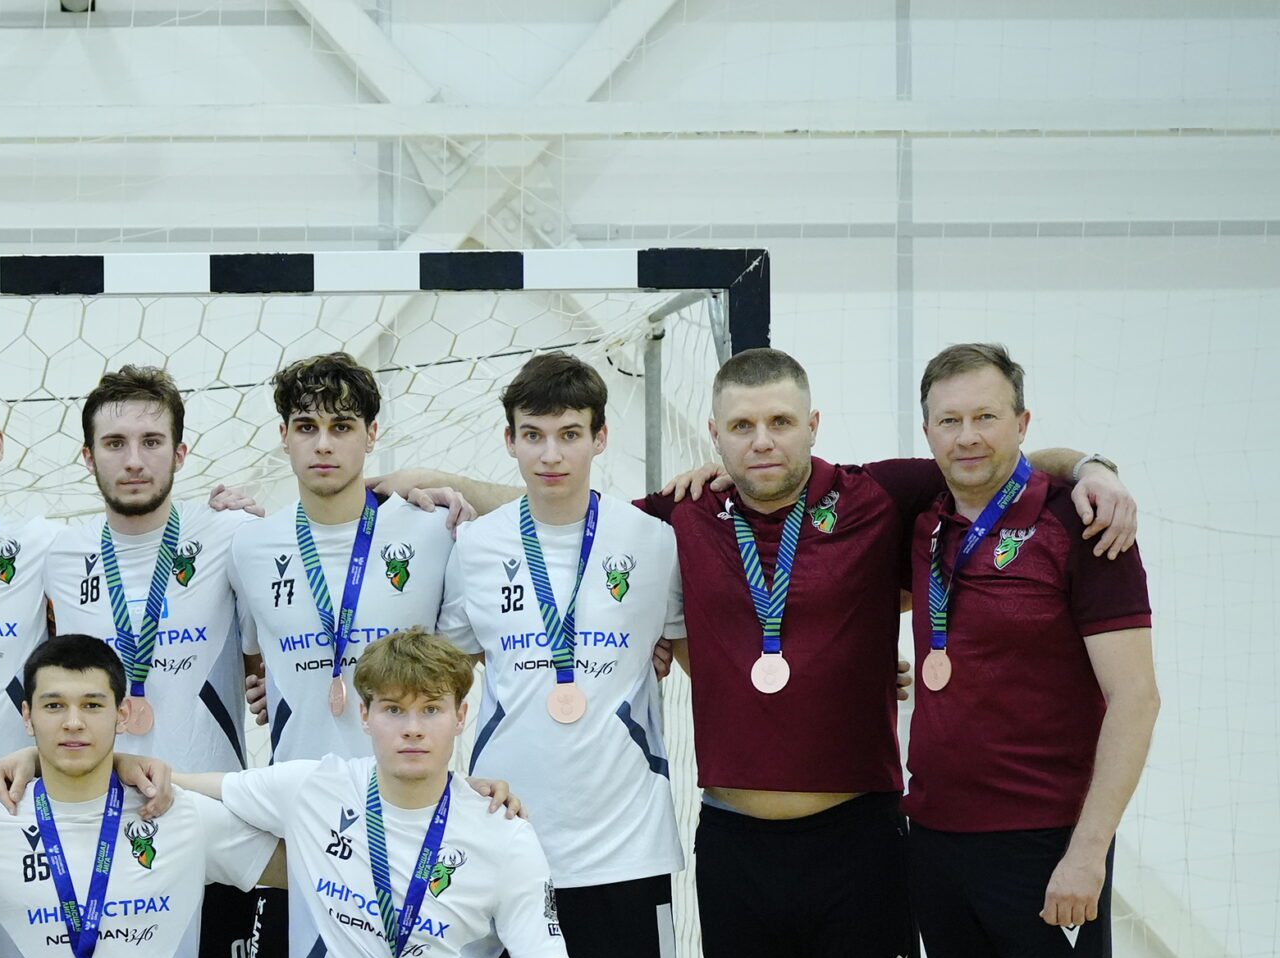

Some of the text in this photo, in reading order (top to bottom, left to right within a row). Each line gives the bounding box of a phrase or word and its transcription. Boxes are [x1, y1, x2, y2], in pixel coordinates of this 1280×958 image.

[80, 576, 100, 605] 98
[272, 579, 295, 607] 77
[501, 585, 524, 613] 32
[500, 632, 630, 651] ИНГОТРАХ
[23, 853, 51, 882] 85
[96, 842, 107, 873] ВЫСШАЯ
[27, 896, 170, 925] ИНСТРАХ
